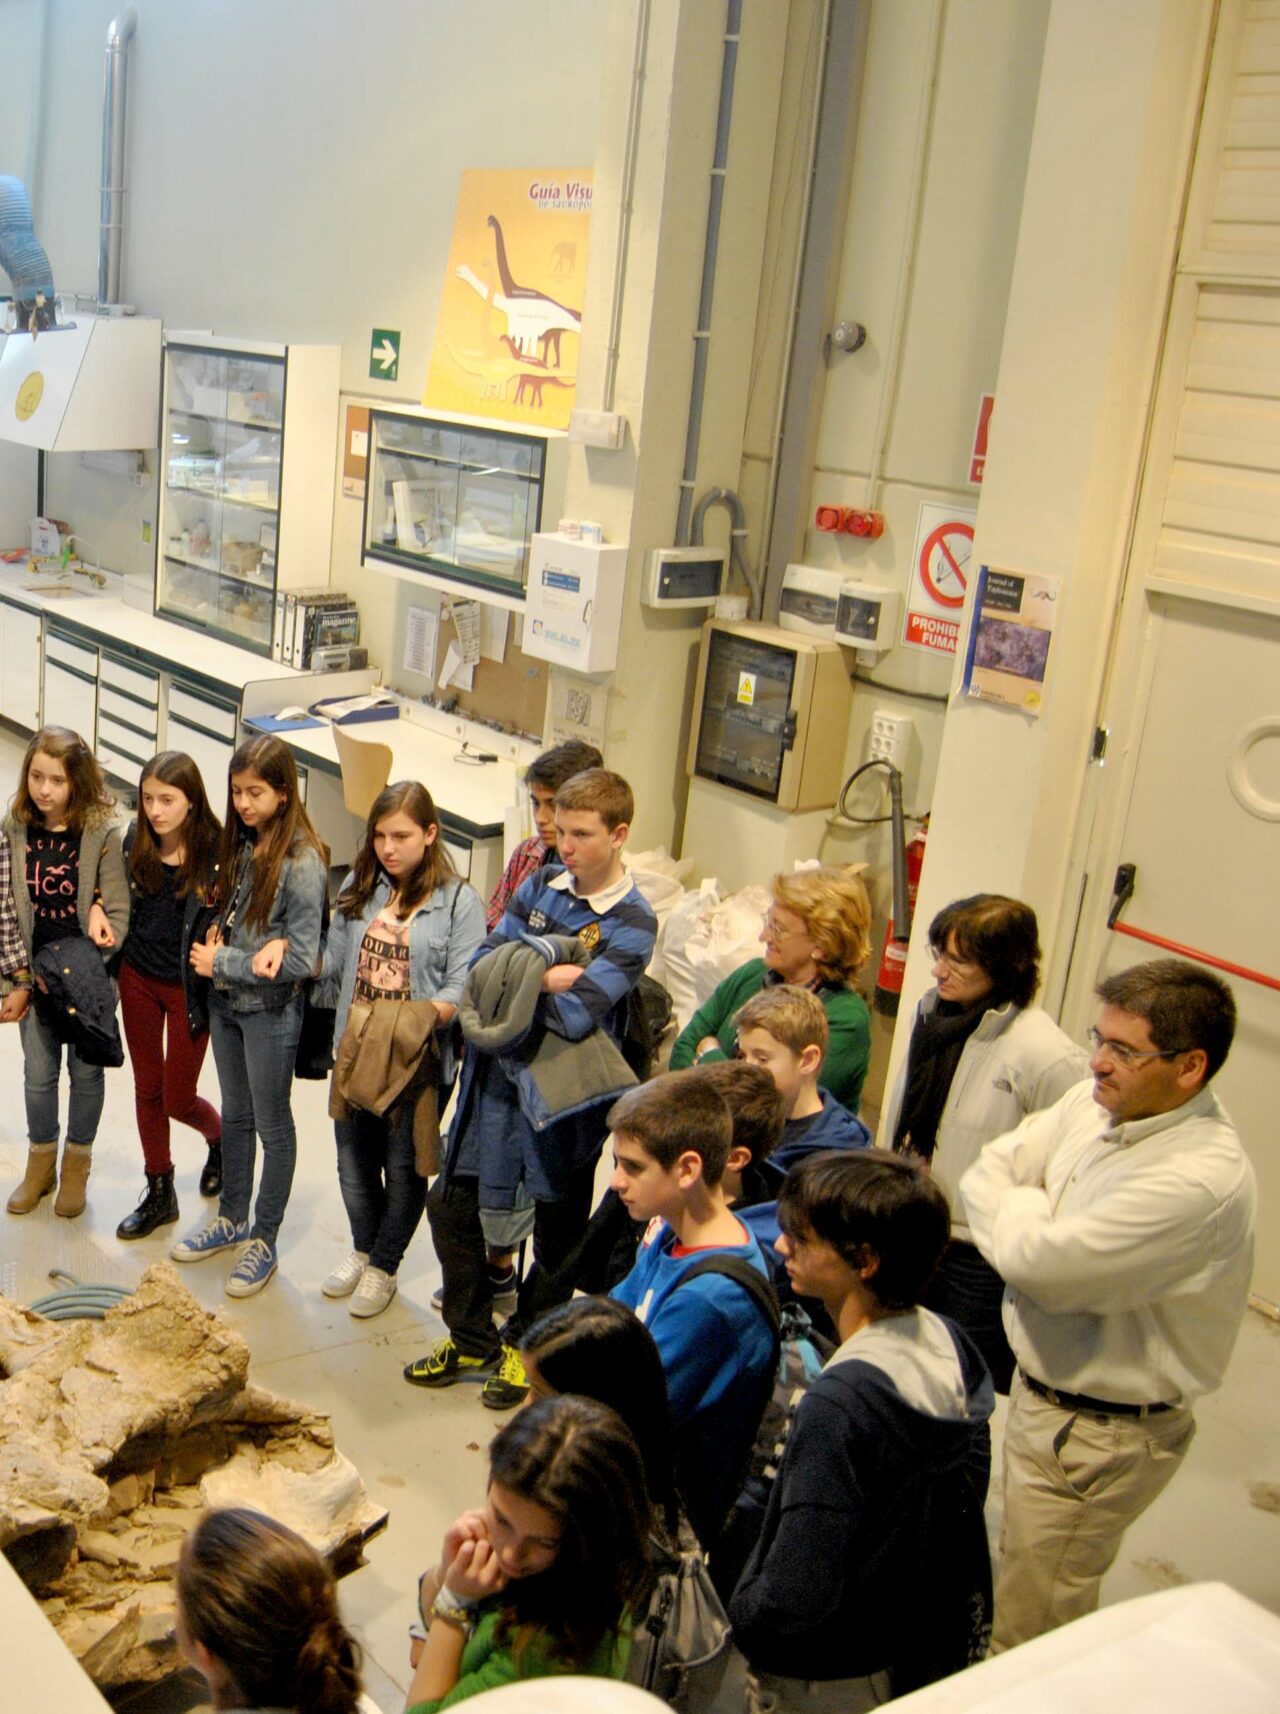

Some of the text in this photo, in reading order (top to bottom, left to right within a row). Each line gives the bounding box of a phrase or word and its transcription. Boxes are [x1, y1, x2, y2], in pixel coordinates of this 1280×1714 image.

[529, 181, 561, 200] Guía
[911, 615, 960, 637] PROHIB
[363, 936, 408, 960] OU AR
[368, 956, 398, 977] US
